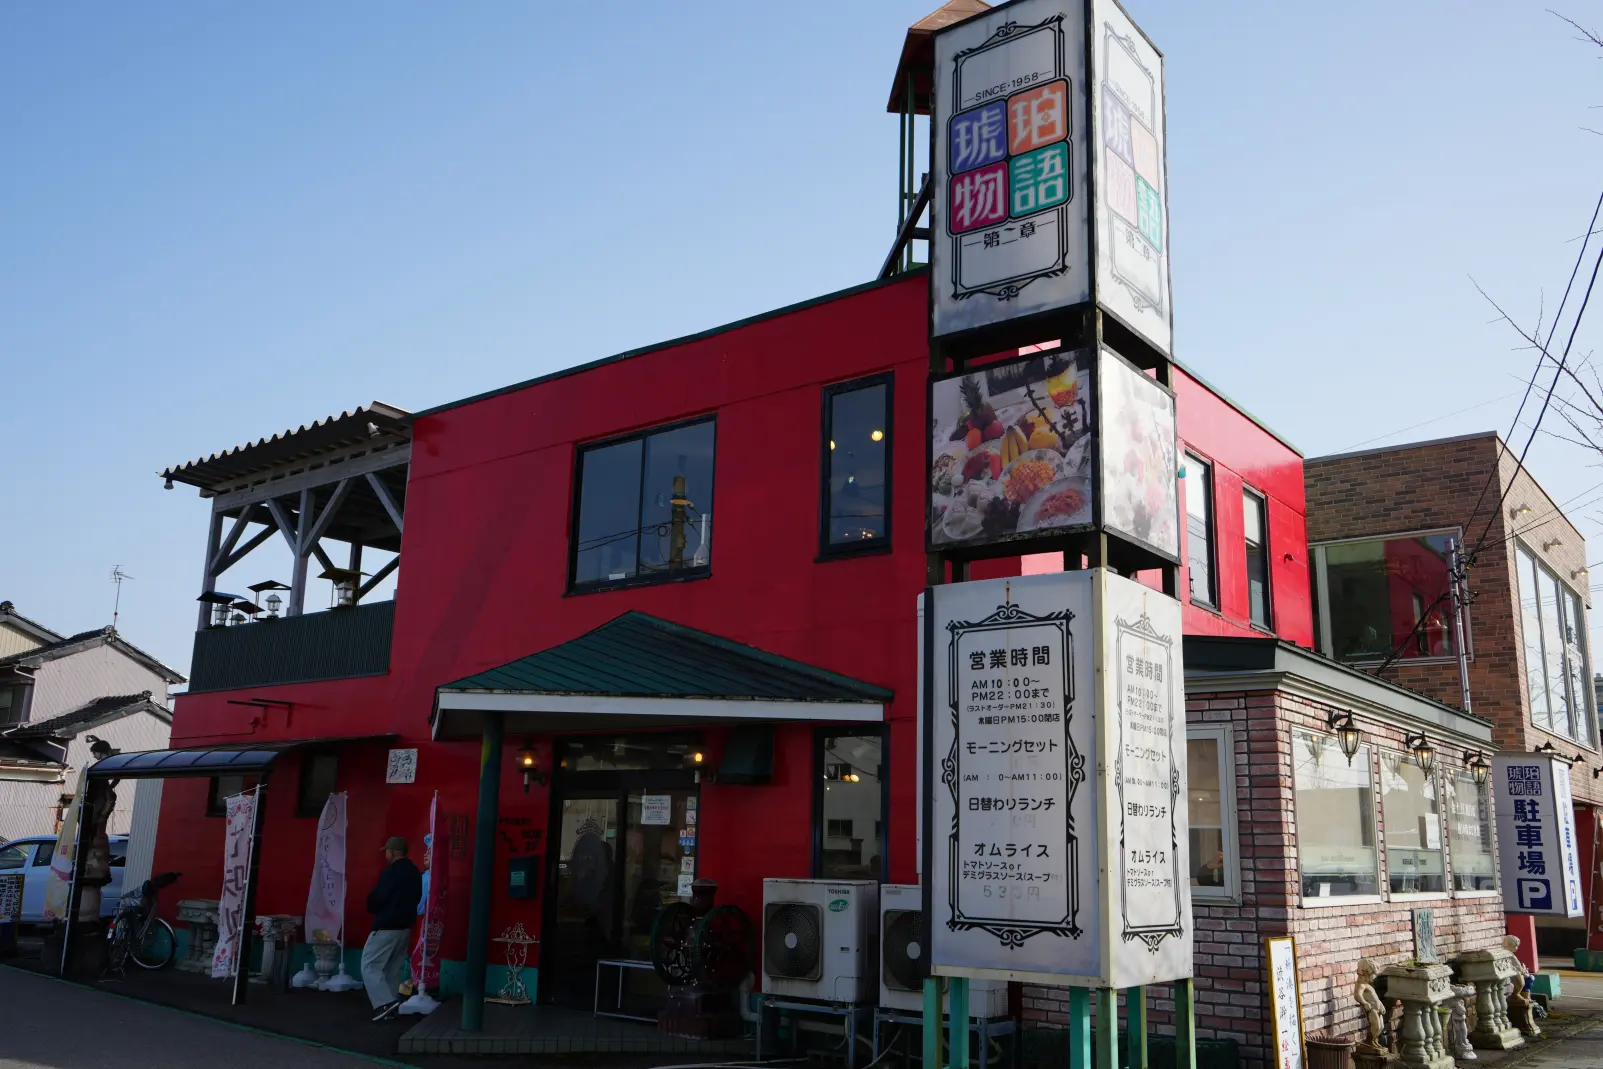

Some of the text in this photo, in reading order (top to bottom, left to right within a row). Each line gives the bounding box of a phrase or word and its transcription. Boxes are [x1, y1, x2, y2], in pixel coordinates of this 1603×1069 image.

[983, 220, 1037, 250] 第二章
[969, 645, 1051, 671] 営業時間
[1125, 653, 1163, 683] 営業時間
[965, 739, 1059, 755] モーニングセット
[1124, 743, 1167, 763] モーニングセット
[968, 797, 1056, 812] 日替わりランチ
[1127, 801, 1167, 819] 日替わりランチ
[1512, 798, 1546, 876] 駐車場
[973, 842, 1051, 859] オムライス
[1131, 850, 1167, 864] オムライス
[1520, 880, 1549, 909] P
